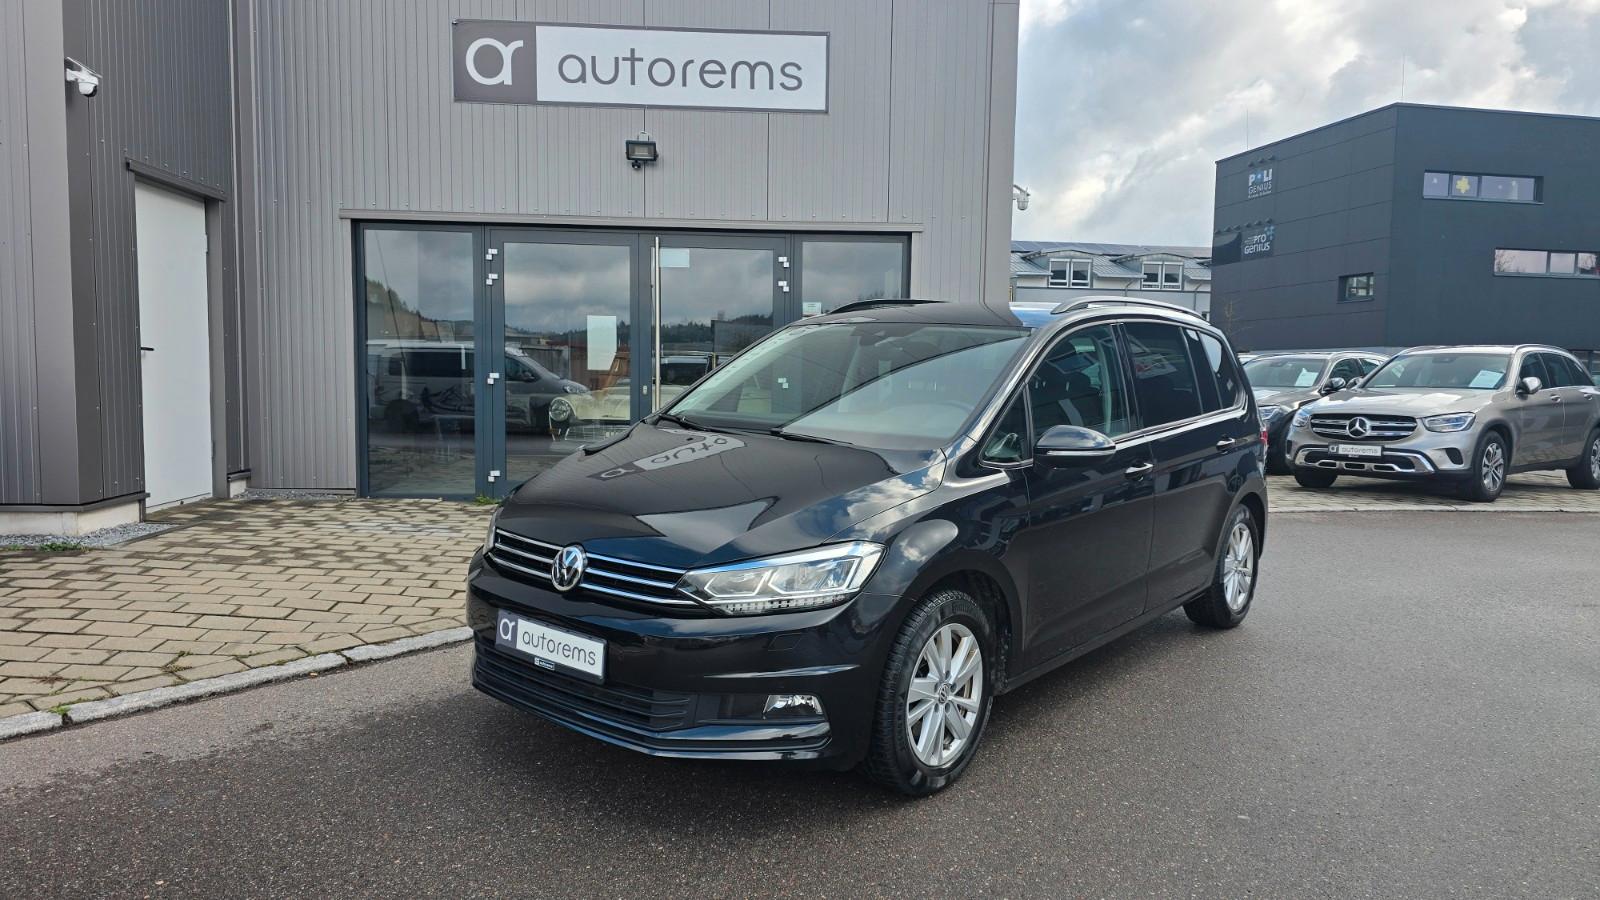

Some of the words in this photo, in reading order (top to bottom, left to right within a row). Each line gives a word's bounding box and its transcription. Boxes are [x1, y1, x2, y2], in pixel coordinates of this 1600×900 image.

[557, 47, 803, 91] autorems
[1248, 181, 1272, 194] GENIUS
[522, 630, 596, 666] autorems
